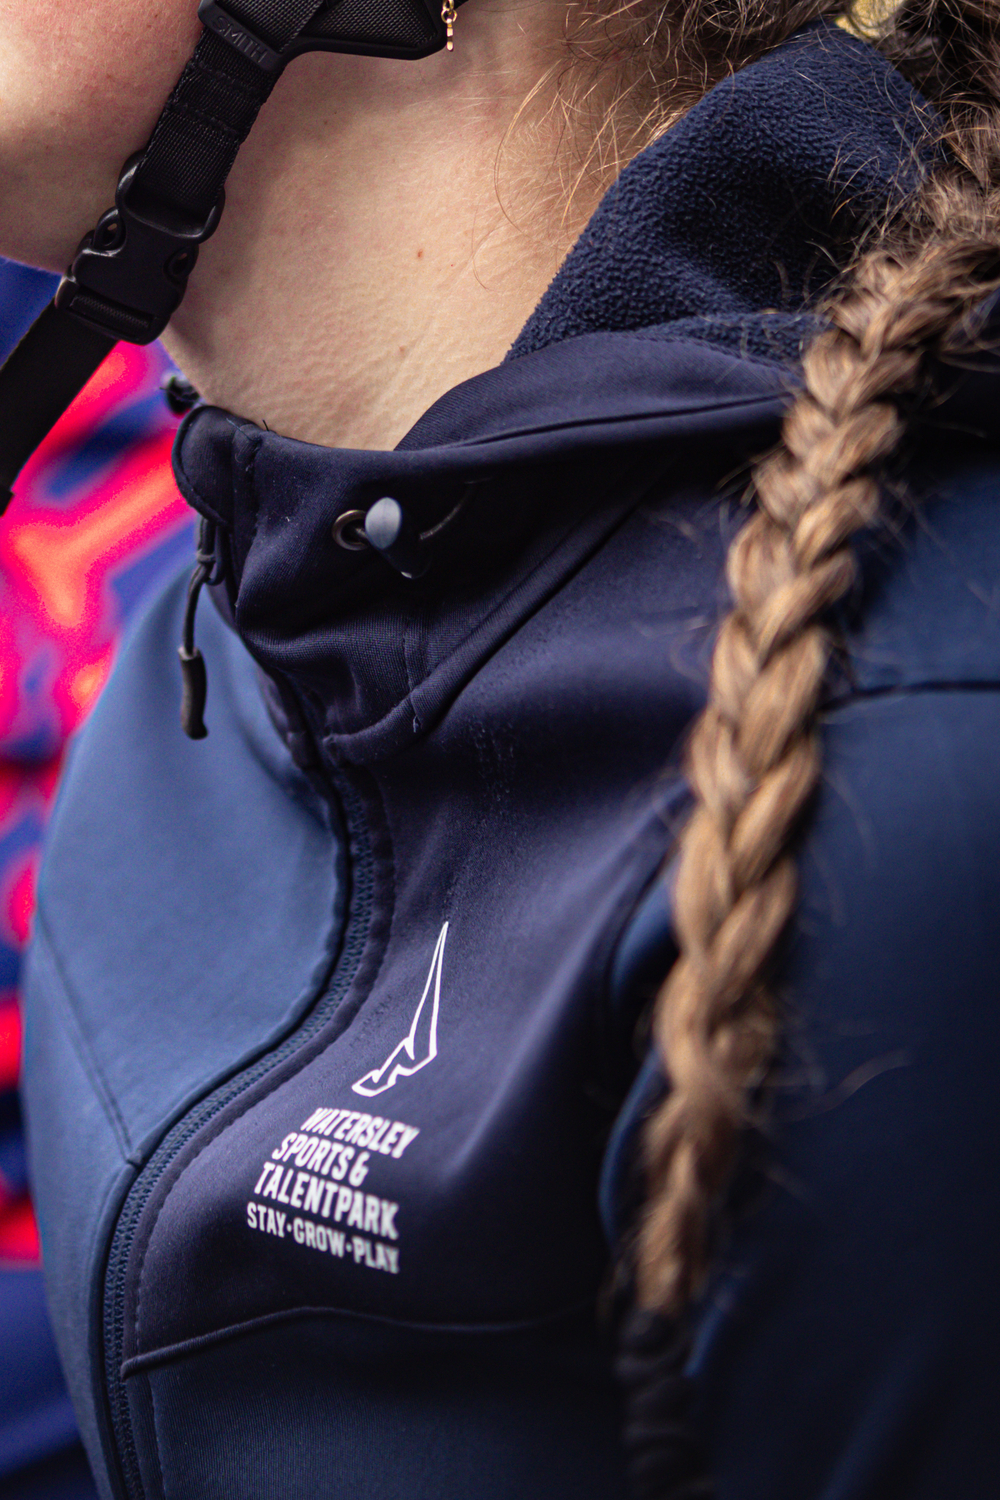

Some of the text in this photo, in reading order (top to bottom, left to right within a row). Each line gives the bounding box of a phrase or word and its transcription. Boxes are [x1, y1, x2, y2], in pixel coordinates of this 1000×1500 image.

[211, 15, 268, 64] SMITH
[271, 1132, 370, 1187] SPORTS &
[300, 1107, 420, 1159] WATERSLEY
[254, 1161, 399, 1240] TALENTPARK
